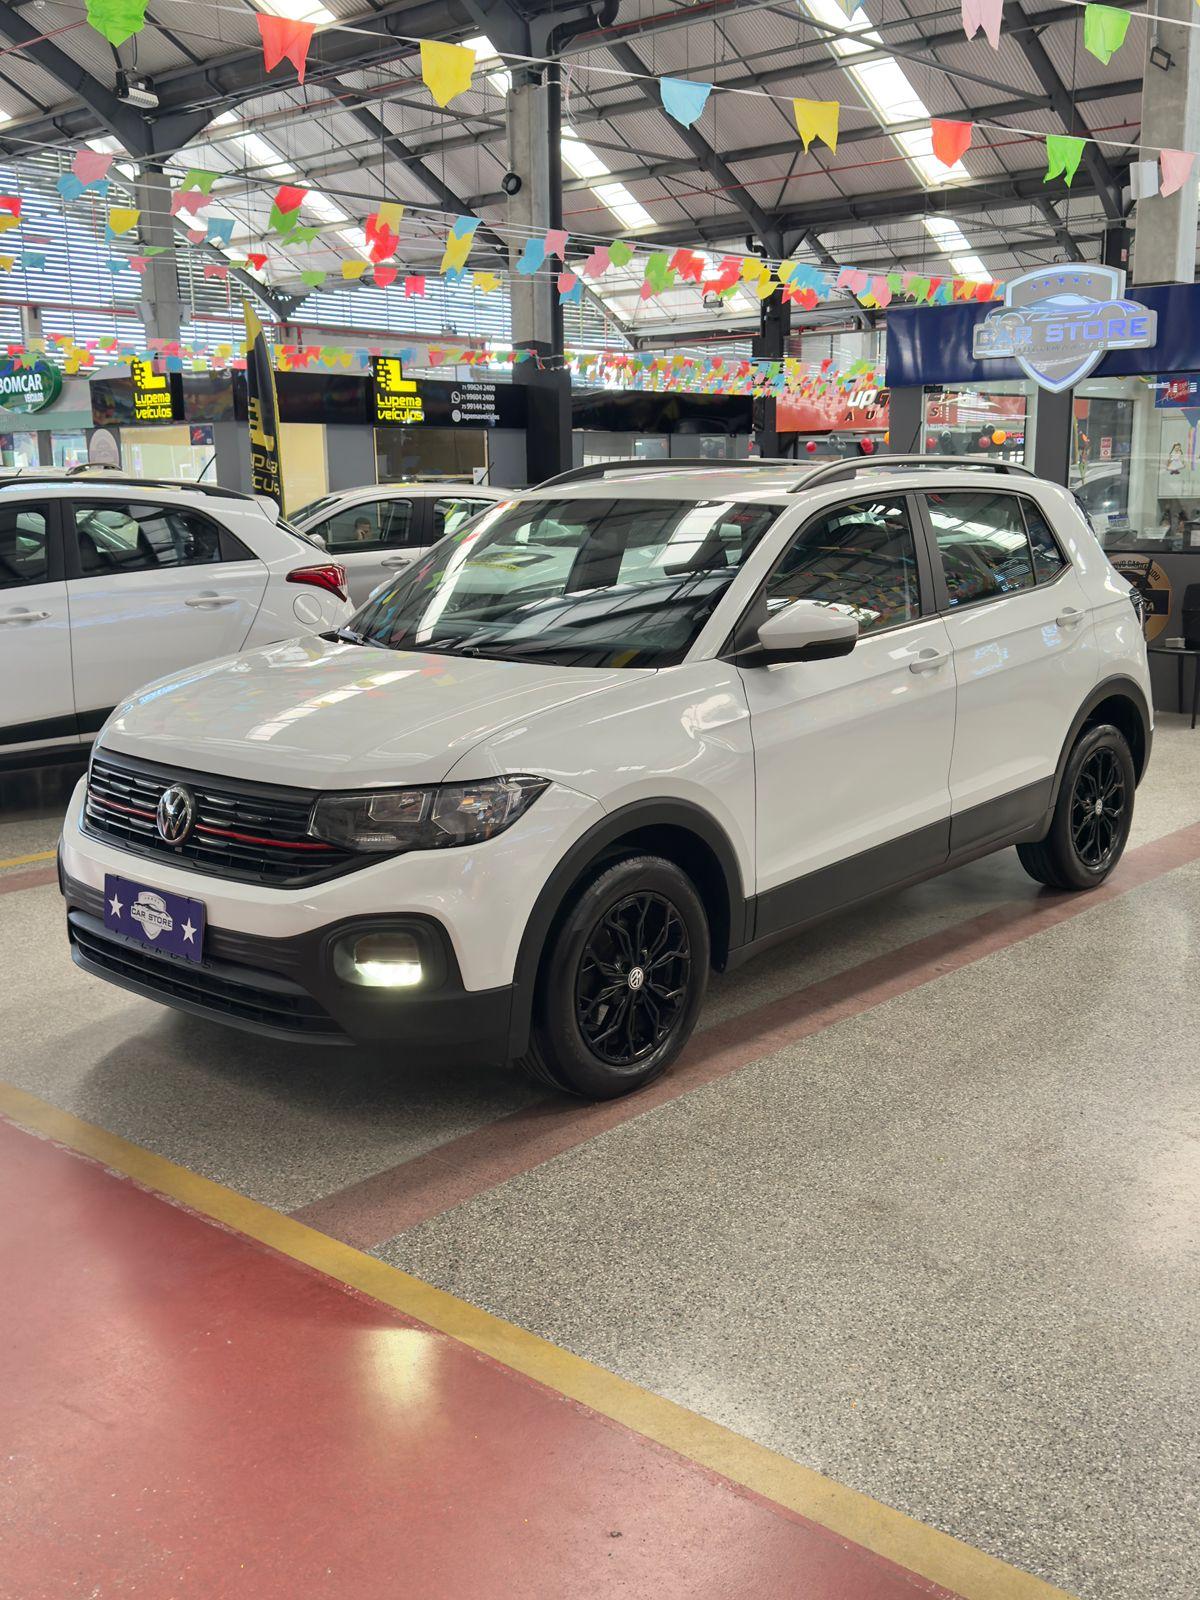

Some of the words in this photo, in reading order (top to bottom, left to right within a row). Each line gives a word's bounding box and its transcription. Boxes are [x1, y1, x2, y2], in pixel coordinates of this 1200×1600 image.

[976, 326, 1033, 347] CAR
[1045, 316, 1148, 342] STORE
[134, 392, 171, 405] Lupema
[377, 393, 422, 406] Lupema
[136, 406, 172, 418] veículos
[378, 408, 424, 421] veículos
[131, 906, 146, 918] CAR
[148, 914, 173, 928] STORE
